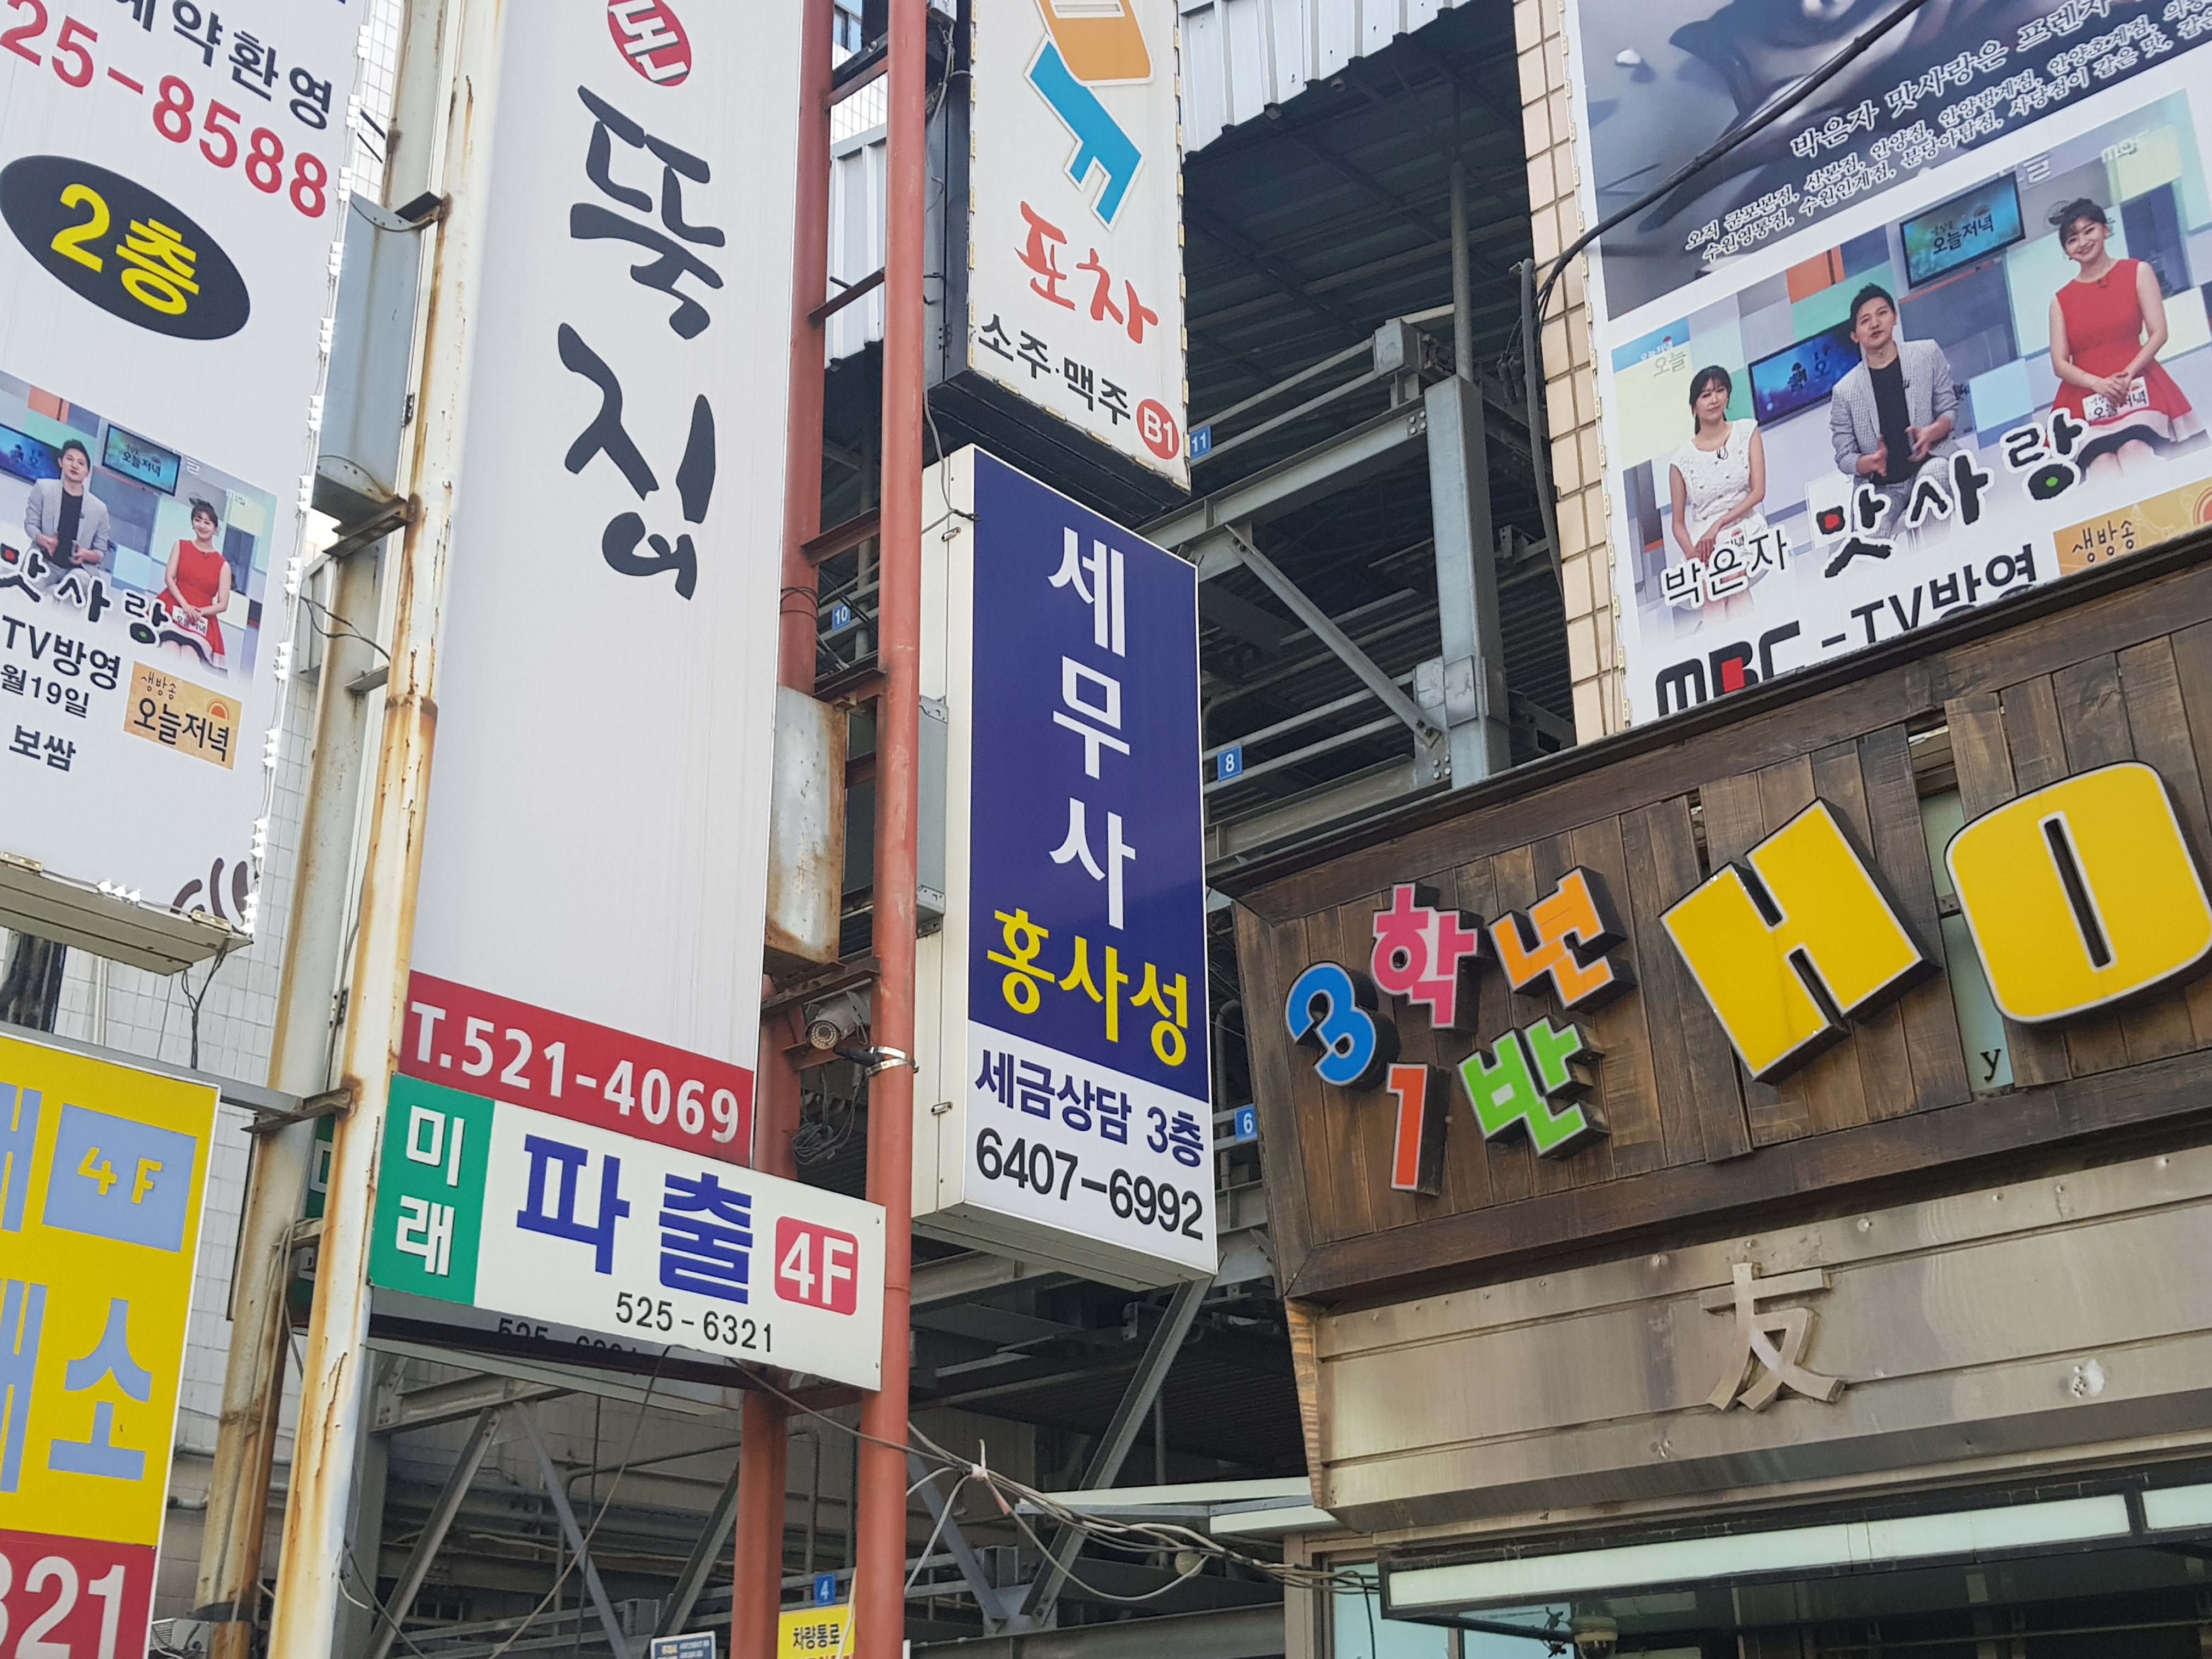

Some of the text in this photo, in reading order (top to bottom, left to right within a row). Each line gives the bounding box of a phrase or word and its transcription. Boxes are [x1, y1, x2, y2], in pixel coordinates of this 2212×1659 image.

[1790, 100, 1879, 158] 박은자
[1885, 40, 2008, 119] 맛사랑은
[2008, 66, 2089, 117] 사당점이
[2092, 46, 2139, 79] 같은
[50, 184, 199, 315] 2층
[1685, 219, 1719, 251] 오직
[1933, 213, 1994, 255] 오늘저녁
[1014, 201, 1158, 344] 포차
[122, 451, 161, 477] 오늘저녁
[1143, 406, 1173, 453] B1
[1192, 432, 1206, 453] 11
[1816, 413, 2083, 579] 맛사랑
[1666, 529, 1787, 602] 박은자
[2072, 519, 2136, 563] 생방송
[0, 543, 169, 644] 맛사랑
[835, 606, 848, 625] 10
[2, 614, 121, 690] TV방영
[140, 671, 177, 701] 생방송
[1, 663, 90, 719] 월19일
[9, 725, 77, 772] 보쌈
[133, 697, 229, 763] 오늘저녁
[1047, 526, 1136, 930] 세무사
[1224, 753, 1235, 773] 8
[986, 908, 1189, 1066] 홍사성
[411, 1000, 739, 1144] T.521-4069
[975, 1048, 1204, 1167] 세금상담 3층
[1386, 1016, 1588, 1192] 1반
[1243, 1112, 1254, 1133] 6
[77, 1146, 163, 1204] 4F
[395, 1105, 466, 1277] 미래
[976, 1127, 1203, 1241] 6407-6992
[516, 1133, 854, 1306] 파출 4F
[616, 1292, 772, 1353] 525-6321
[0, 1552, 126, 1659] 21
[793, 1623, 840, 1650] 차량통로
